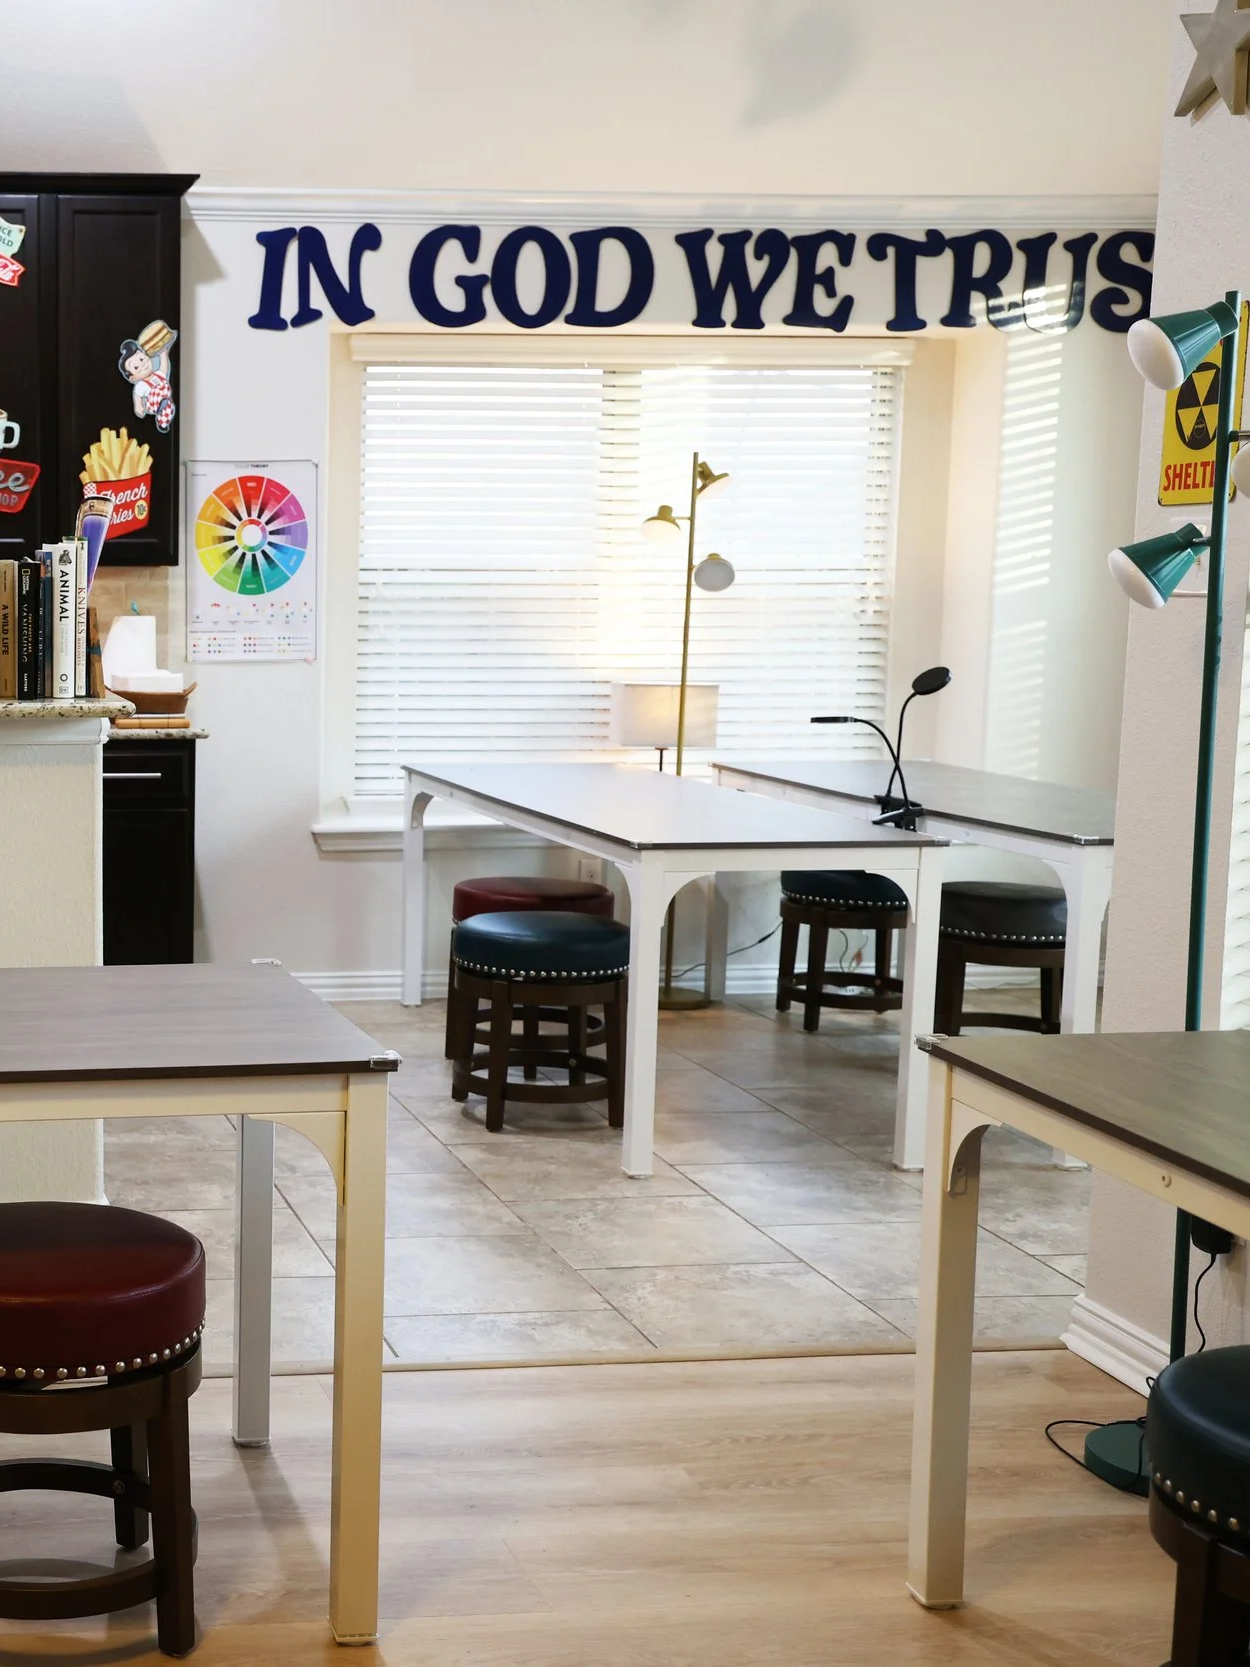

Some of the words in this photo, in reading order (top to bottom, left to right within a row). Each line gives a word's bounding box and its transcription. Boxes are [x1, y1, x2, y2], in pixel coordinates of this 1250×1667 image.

[248, 223, 382, 331] IN
[409, 224, 655, 329] GOD
[675, 228, 856, 332] WE
[867, 228, 1155, 335] TRUS
[1163, 461, 1214, 491] SHELT
[110, 508, 135, 525] ries
[59, 570, 70, 622] ANIMAL
[77, 587, 86, 635] KNIVES
